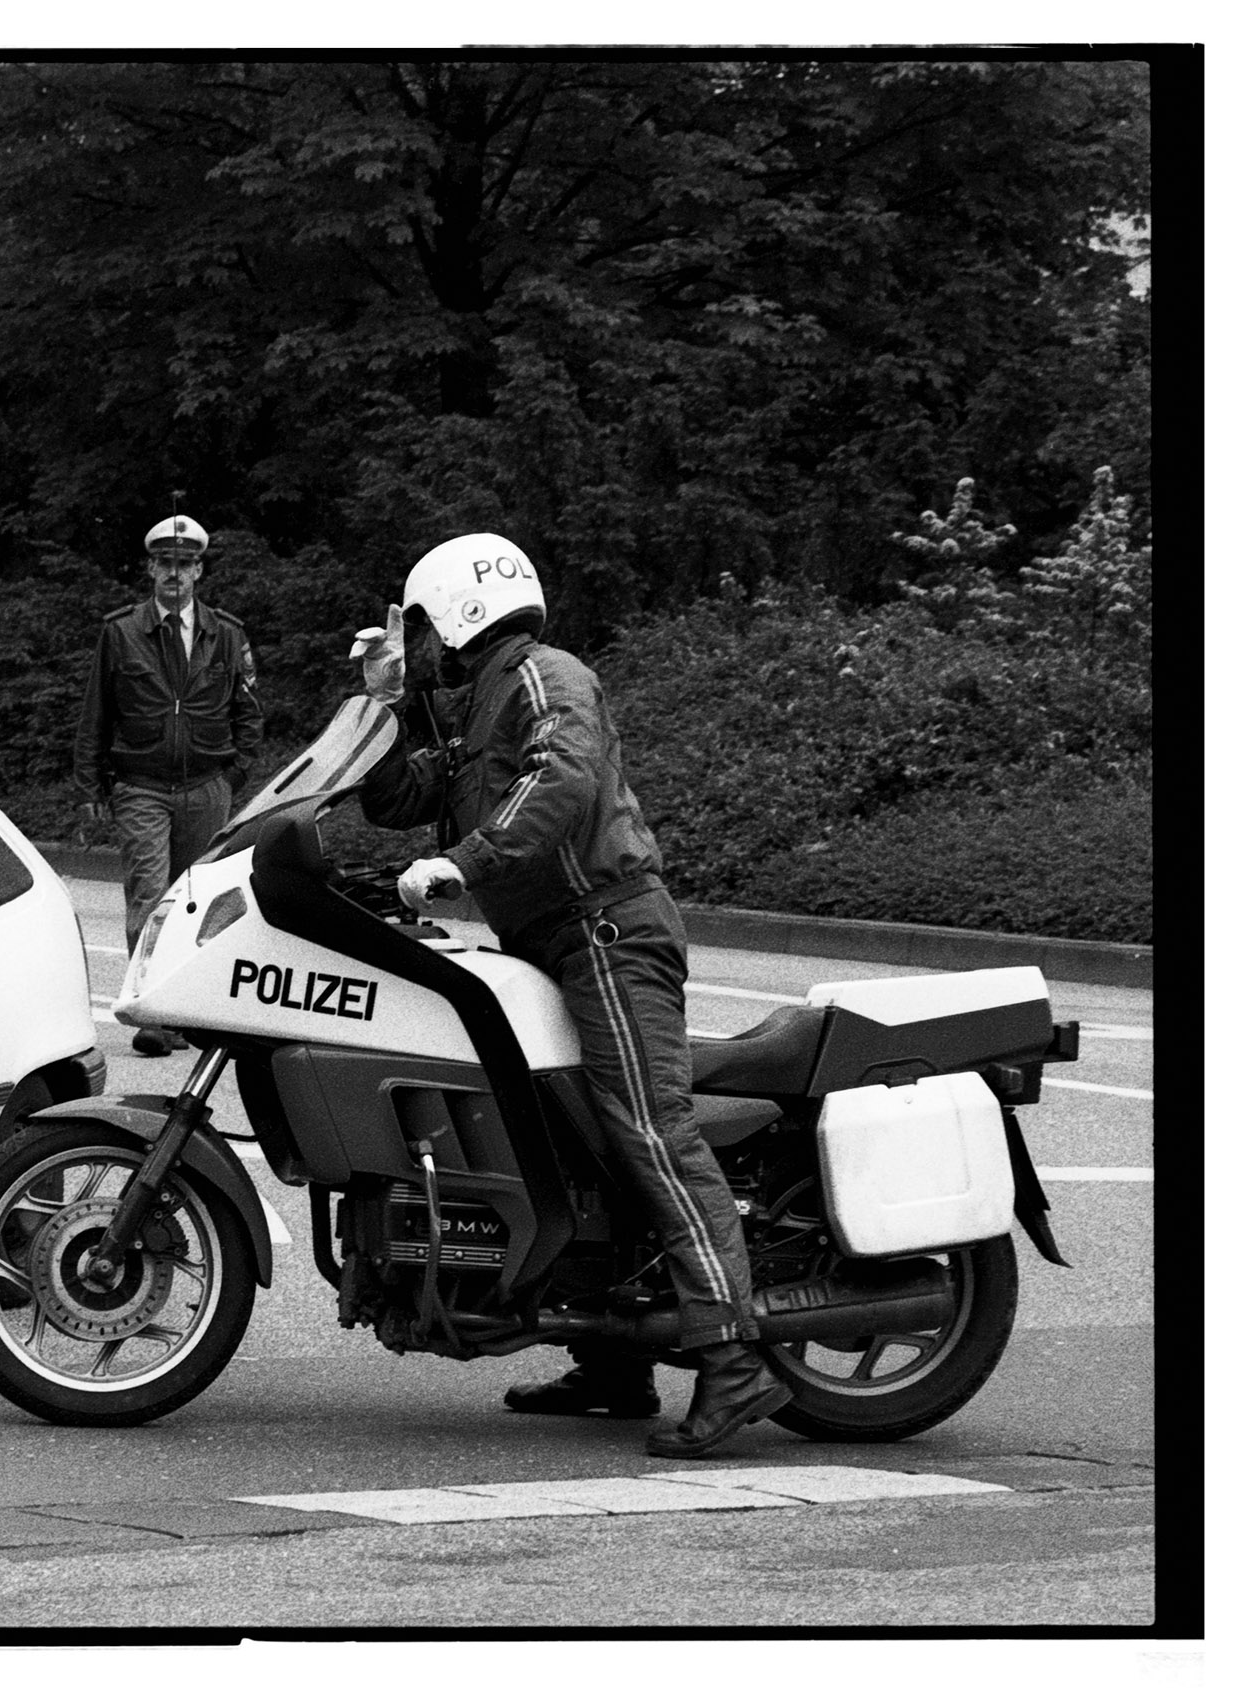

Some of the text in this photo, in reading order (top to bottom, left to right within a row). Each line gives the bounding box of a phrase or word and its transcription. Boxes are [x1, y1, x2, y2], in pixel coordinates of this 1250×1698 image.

[472, 555, 533, 584] POL
[229, 958, 379, 1021] POLIZEI
[439, 1219, 501, 1235] BMW
